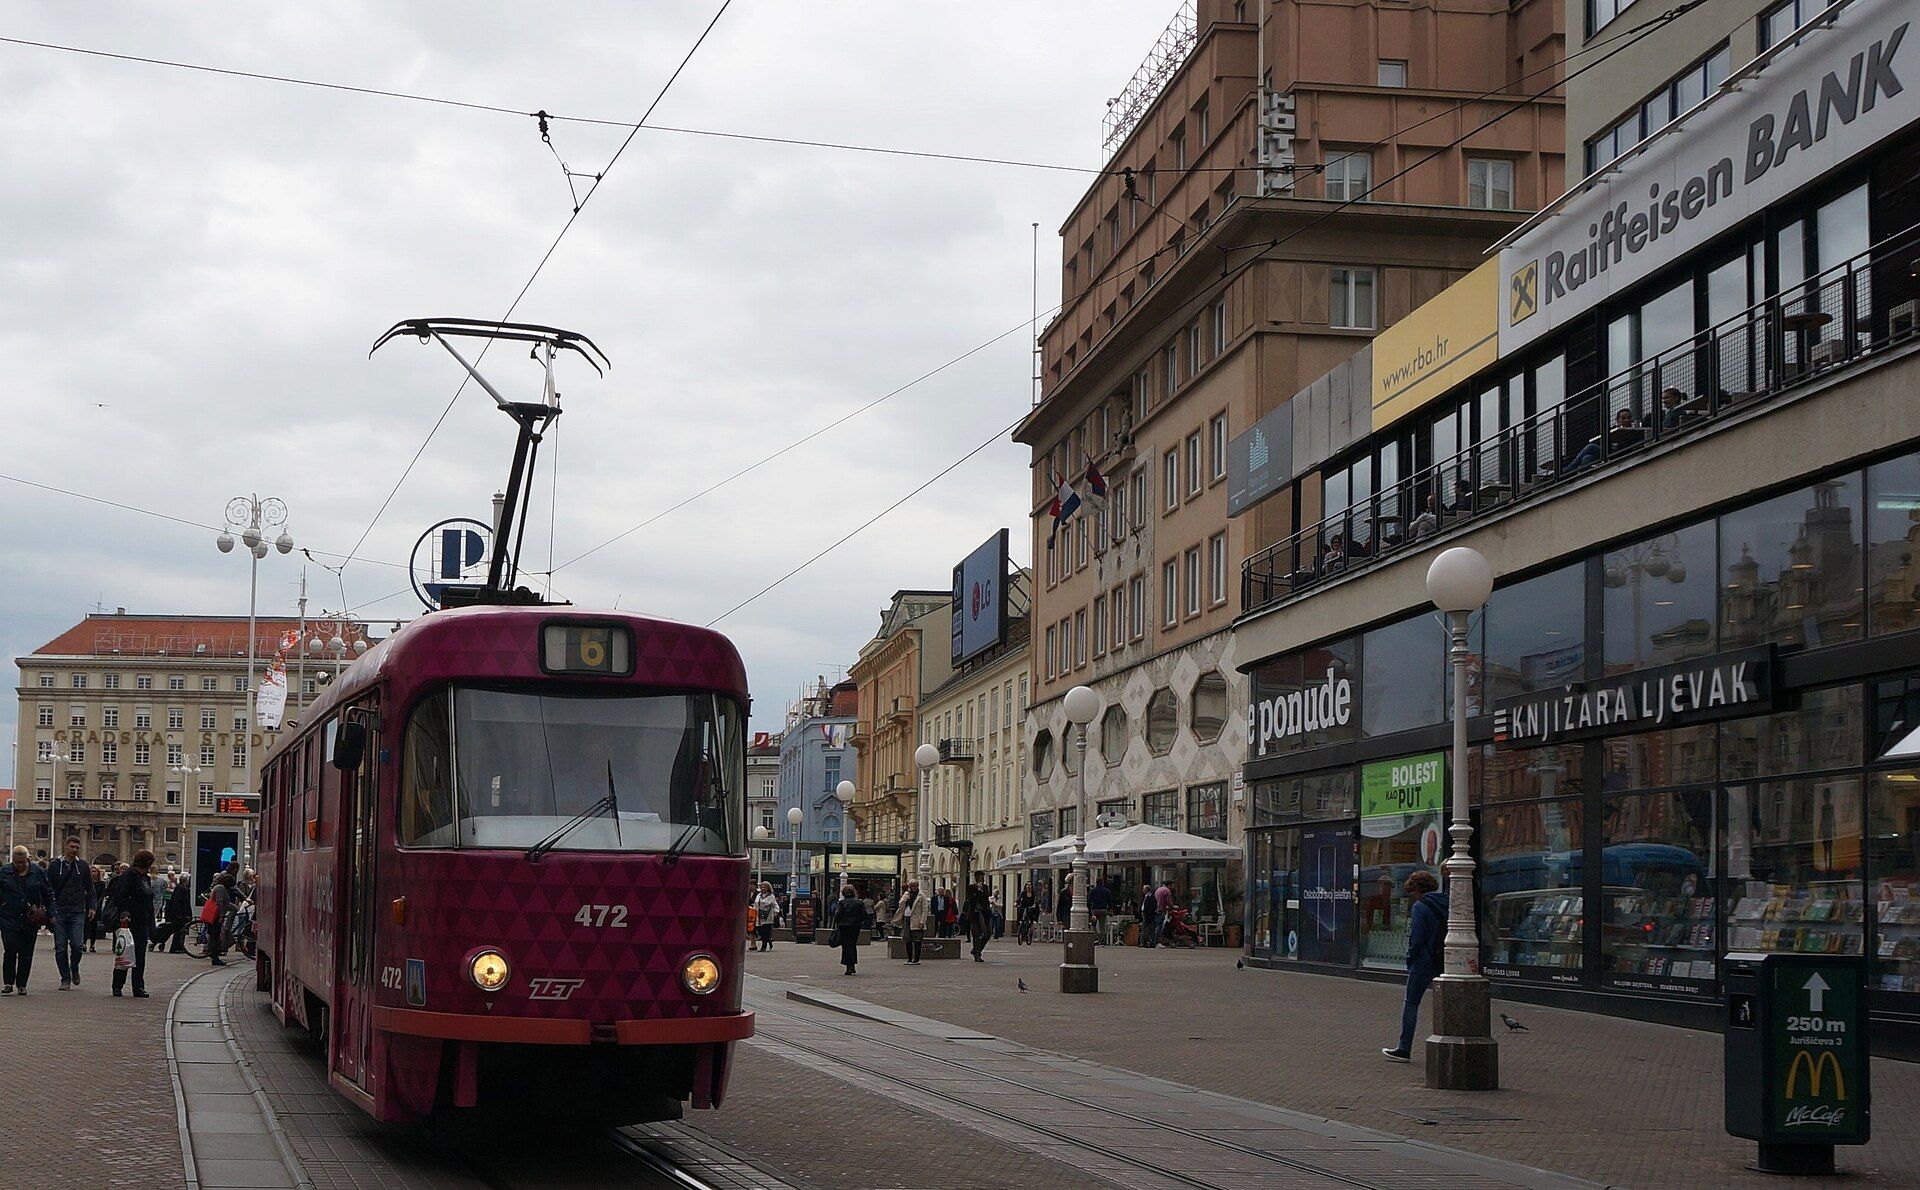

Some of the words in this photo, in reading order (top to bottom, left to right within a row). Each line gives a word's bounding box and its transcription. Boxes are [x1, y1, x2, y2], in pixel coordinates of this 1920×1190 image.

[1545, 156, 1732, 305] Raiffeisen
[1744, 21, 1910, 185] BANK
[1382, 334, 1449, 391] www.rba.hr
[981, 579, 991, 610] LG
[581, 629, 604, 667] 6
[1258, 667, 1351, 756] ponude
[1512, 683, 1629, 742] KNJIŽARA
[1642, 661, 1748, 724] LJEVAK
[54, 730, 165, 746] GRADSKA
[1391, 760, 1438, 787] BOLEST
[1398, 786, 1422, 809] PUT
[574, 904, 628, 928] 472
[381, 966, 402, 990] 472
[528, 977, 586, 1001] ZET
[1786, 1016, 1824, 1032] 250
[1826, 1019, 1846, 1033] m
[1835, 1036, 1843, 1046] 3
